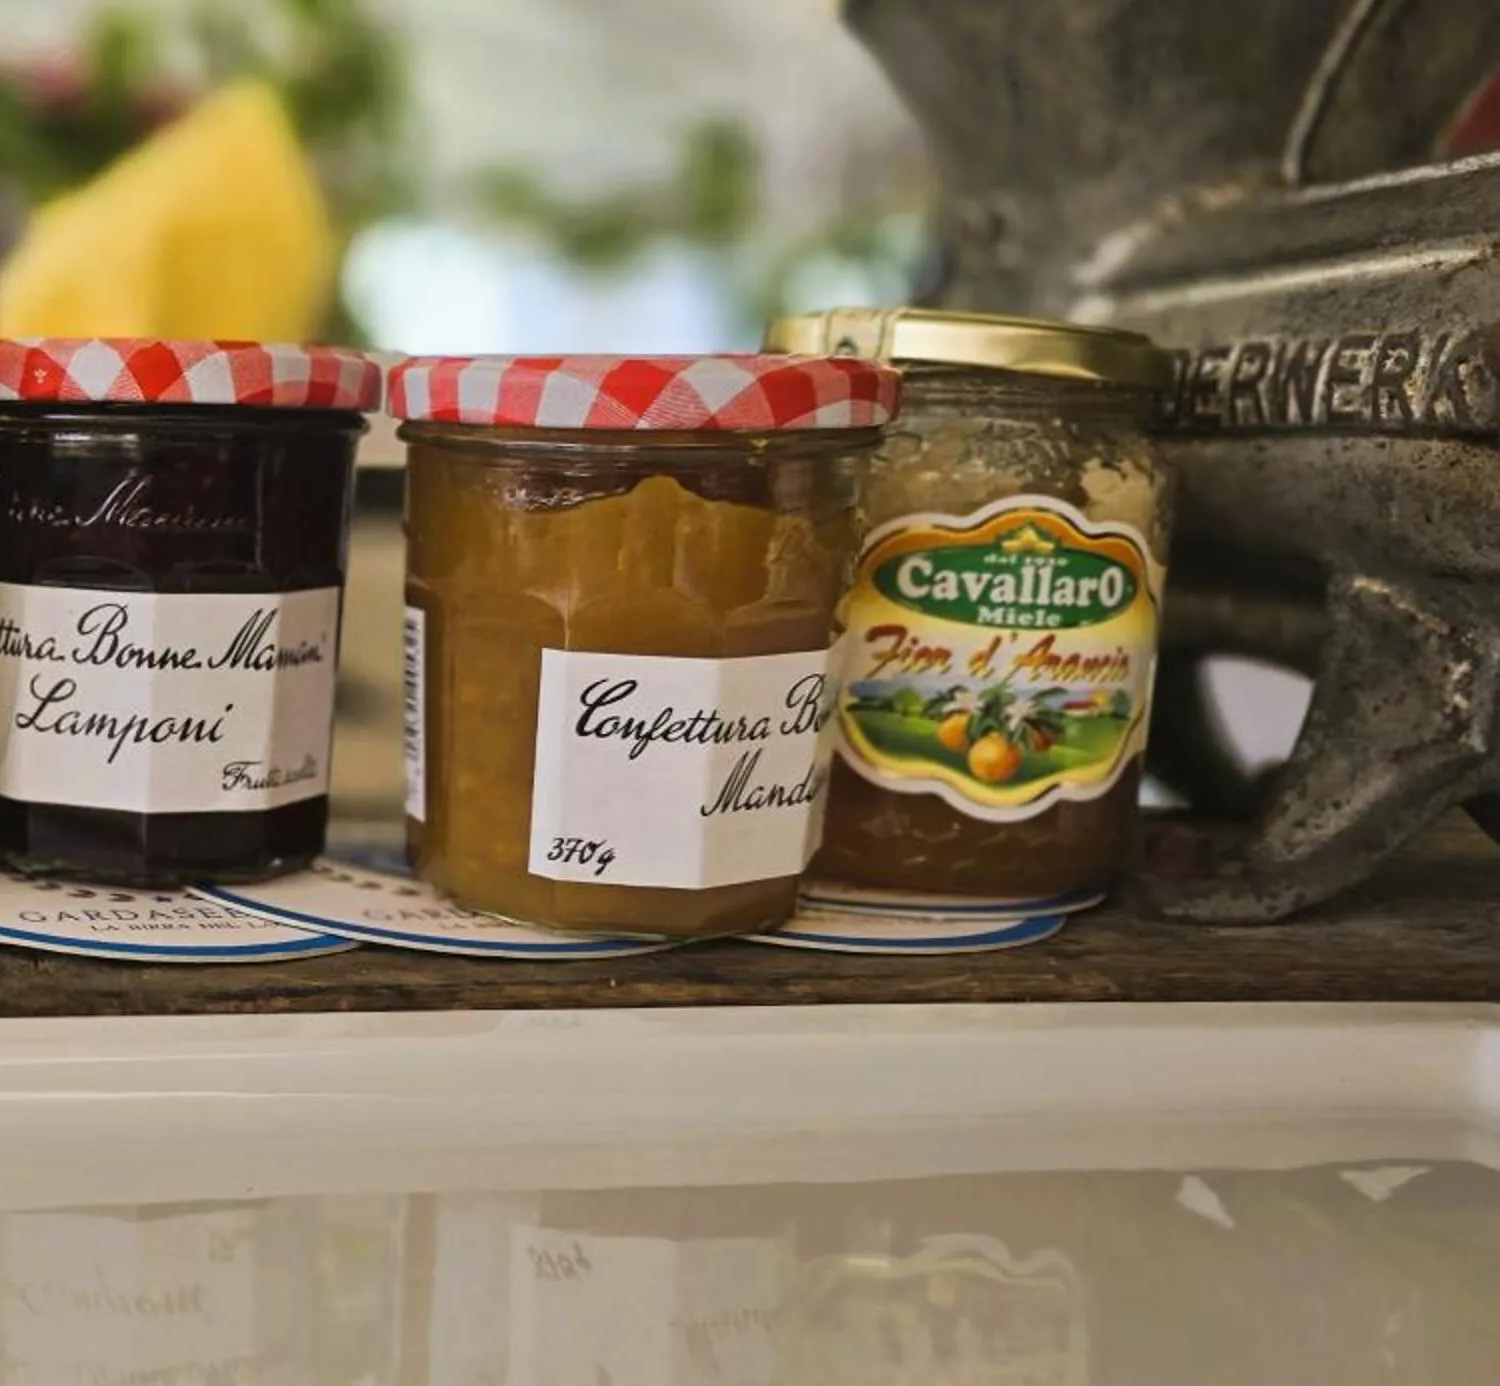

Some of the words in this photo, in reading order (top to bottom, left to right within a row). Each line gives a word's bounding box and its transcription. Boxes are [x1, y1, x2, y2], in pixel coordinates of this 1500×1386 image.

[71, 603, 203, 668] Bonne
[977, 606, 1062, 627] Miele
[864, 624, 952, 679] Fior
[15, 673, 234, 764] Lamponi
[574, 677, 771, 761] Confettura
[547, 837, 615, 876] 370g
